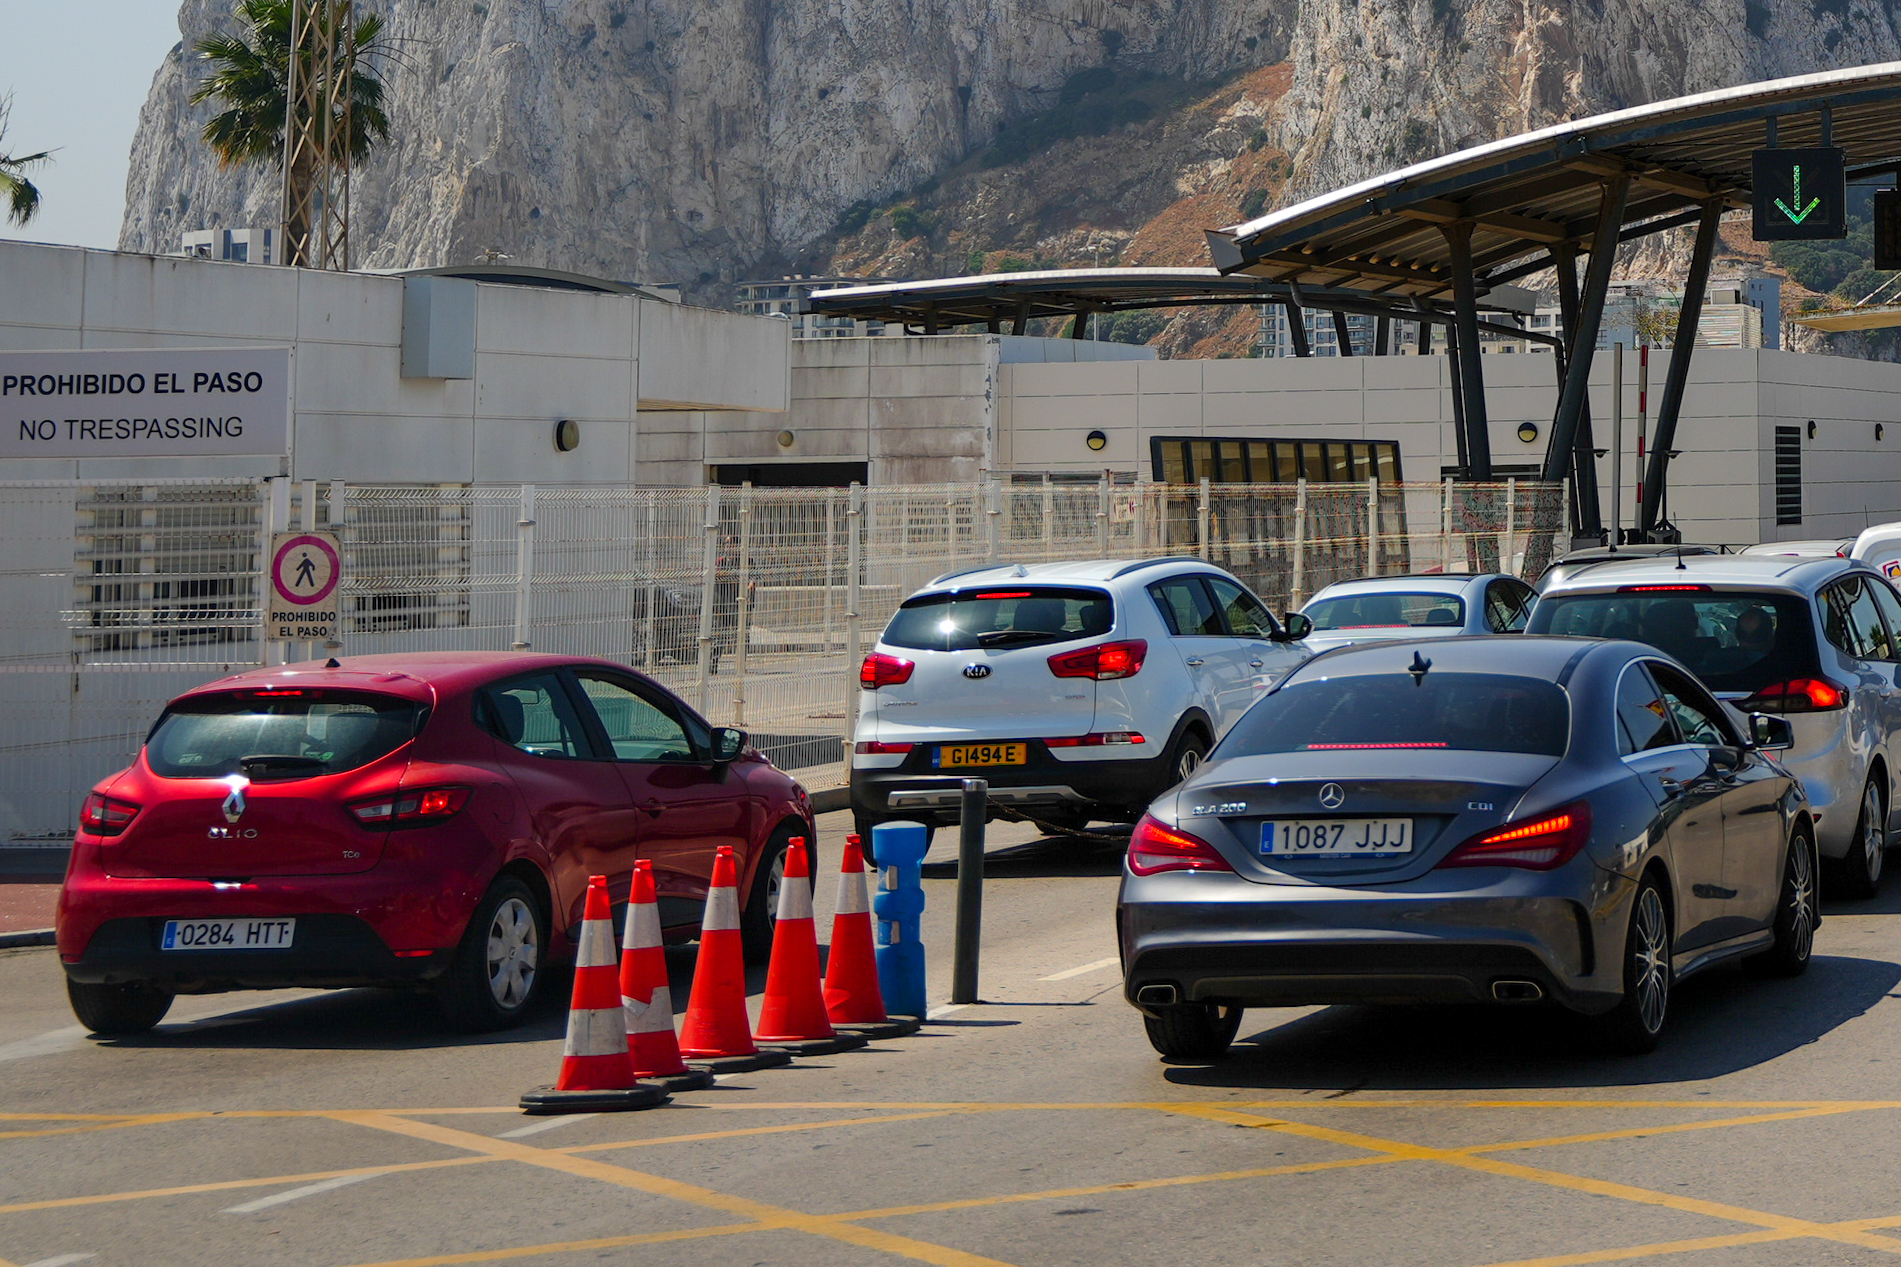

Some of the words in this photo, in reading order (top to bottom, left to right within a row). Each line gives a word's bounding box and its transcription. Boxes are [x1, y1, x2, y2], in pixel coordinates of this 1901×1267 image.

[3, 373, 146, 396] PROHIBIDO
[154, 373, 185, 394] EL
[193, 371, 263, 394] PASO
[20, 420, 57, 440] NO
[65, 416, 243, 440] TRESPASSING
[272, 612, 336, 622] PROHIBIDO
[280, 626, 293, 637] EL
[297, 626, 327, 637] PASO
[966, 666, 987, 676] KIA
[1219, 801, 1247, 814] 200
[1467, 801, 1494, 810] CDI
[207, 827, 258, 839] CLIO
[1283, 824, 1345, 849] 1087
[1355, 823, 1405, 848] JJJ
[1264, 840, 1270, 848] E
[182, 923, 234, 946] 0284
[246, 922, 289, 944] HTT
